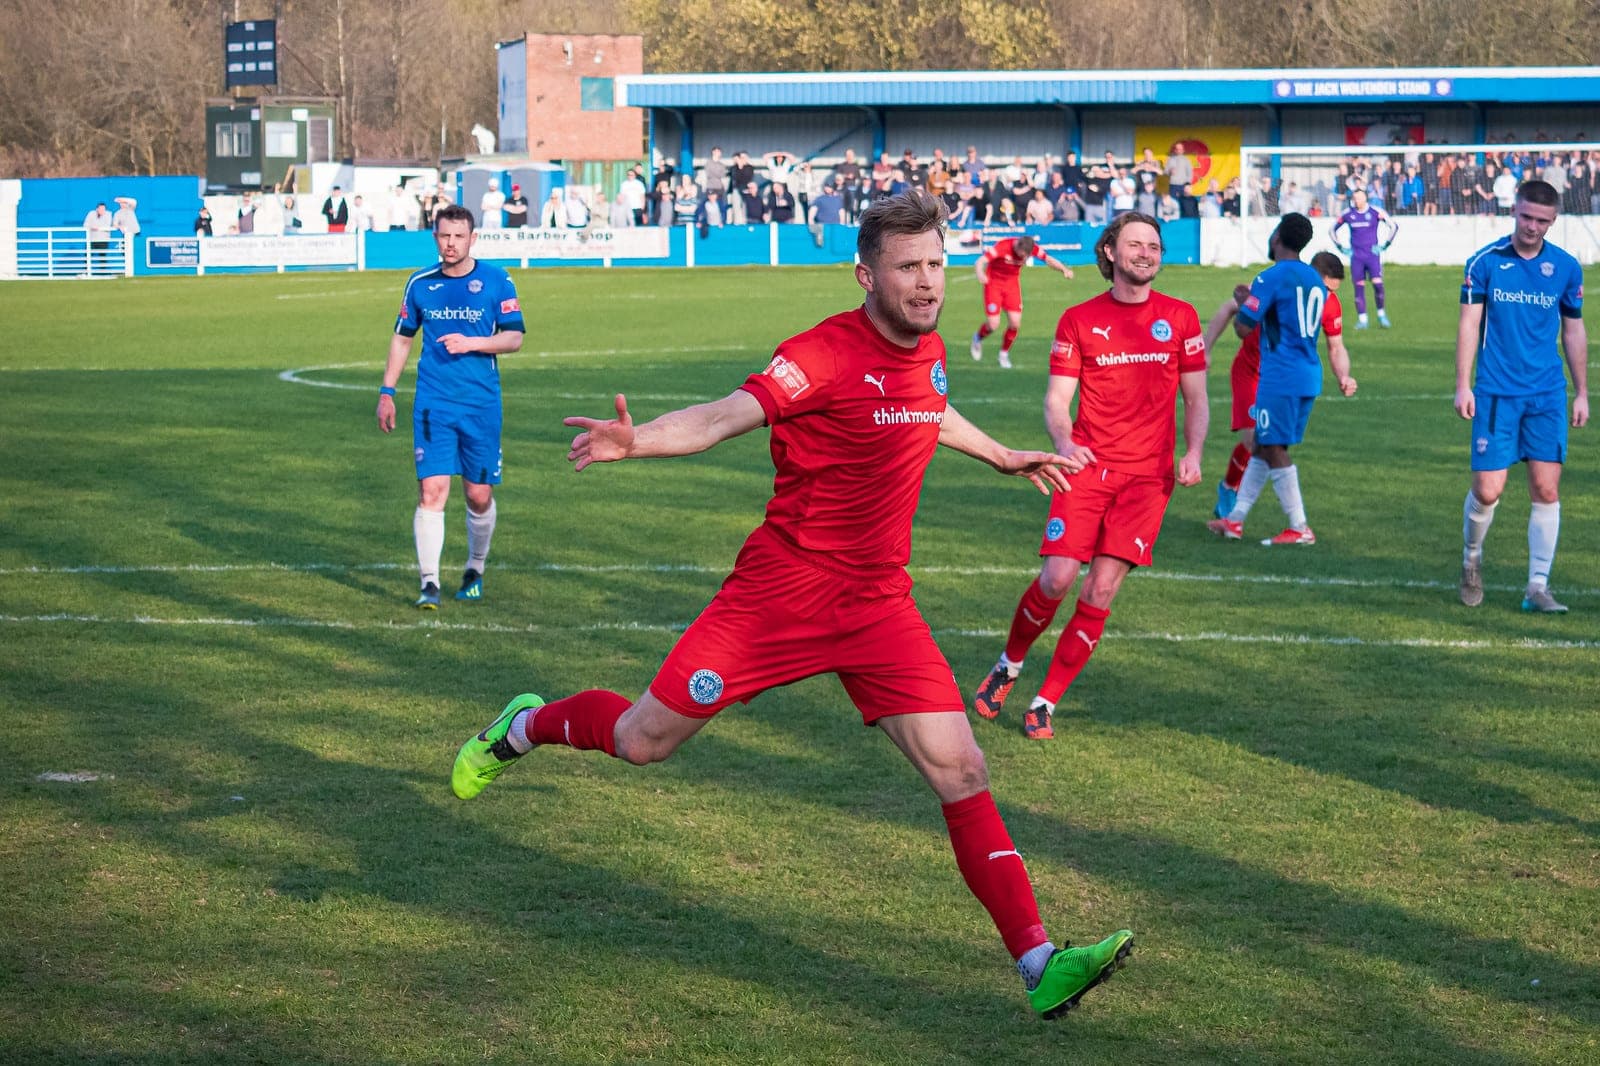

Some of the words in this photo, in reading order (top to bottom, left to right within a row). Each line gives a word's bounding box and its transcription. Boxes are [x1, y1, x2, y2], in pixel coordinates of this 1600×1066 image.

[1294, 81, 1313, 97] THE
[1314, 81, 1339, 97] JACK
[1340, 80, 1397, 96] WOLFENDEN
[1398, 80, 1431, 95] STAND
[478, 231, 511, 240] ino's
[517, 231, 567, 240] Barber
[1493, 288, 1556, 309] Rosebridge
[1296, 286, 1324, 338] 10
[1096, 351, 1170, 366] thinkmoney
